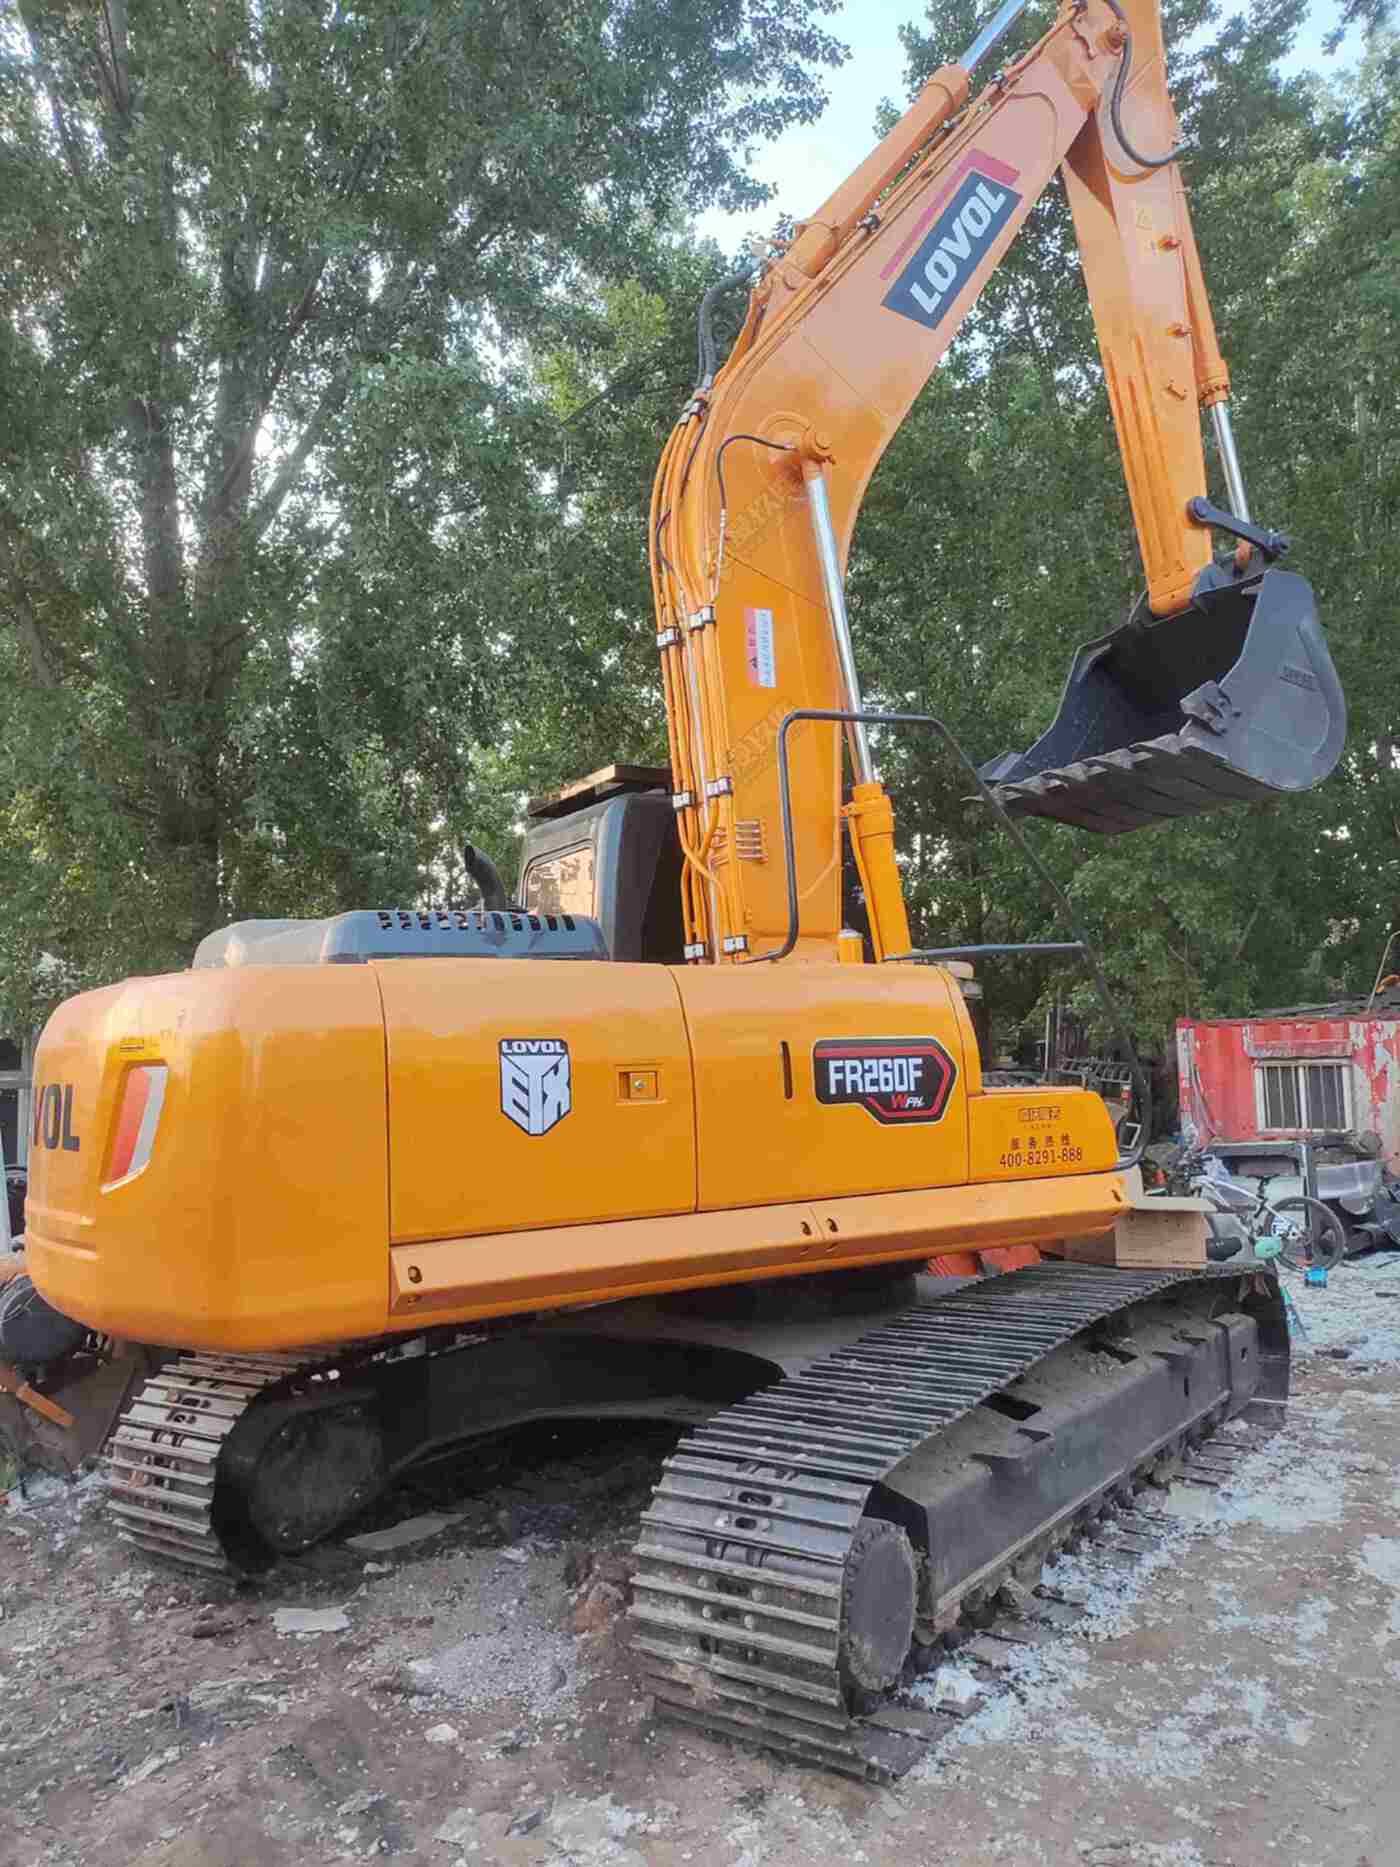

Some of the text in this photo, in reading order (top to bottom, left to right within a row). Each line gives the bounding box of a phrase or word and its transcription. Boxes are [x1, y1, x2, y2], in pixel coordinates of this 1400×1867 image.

[909, 181, 1007, 315] LOVOL
[501, 1040, 566, 1054] LOVOL
[828, 1057, 924, 1095] FR260F
